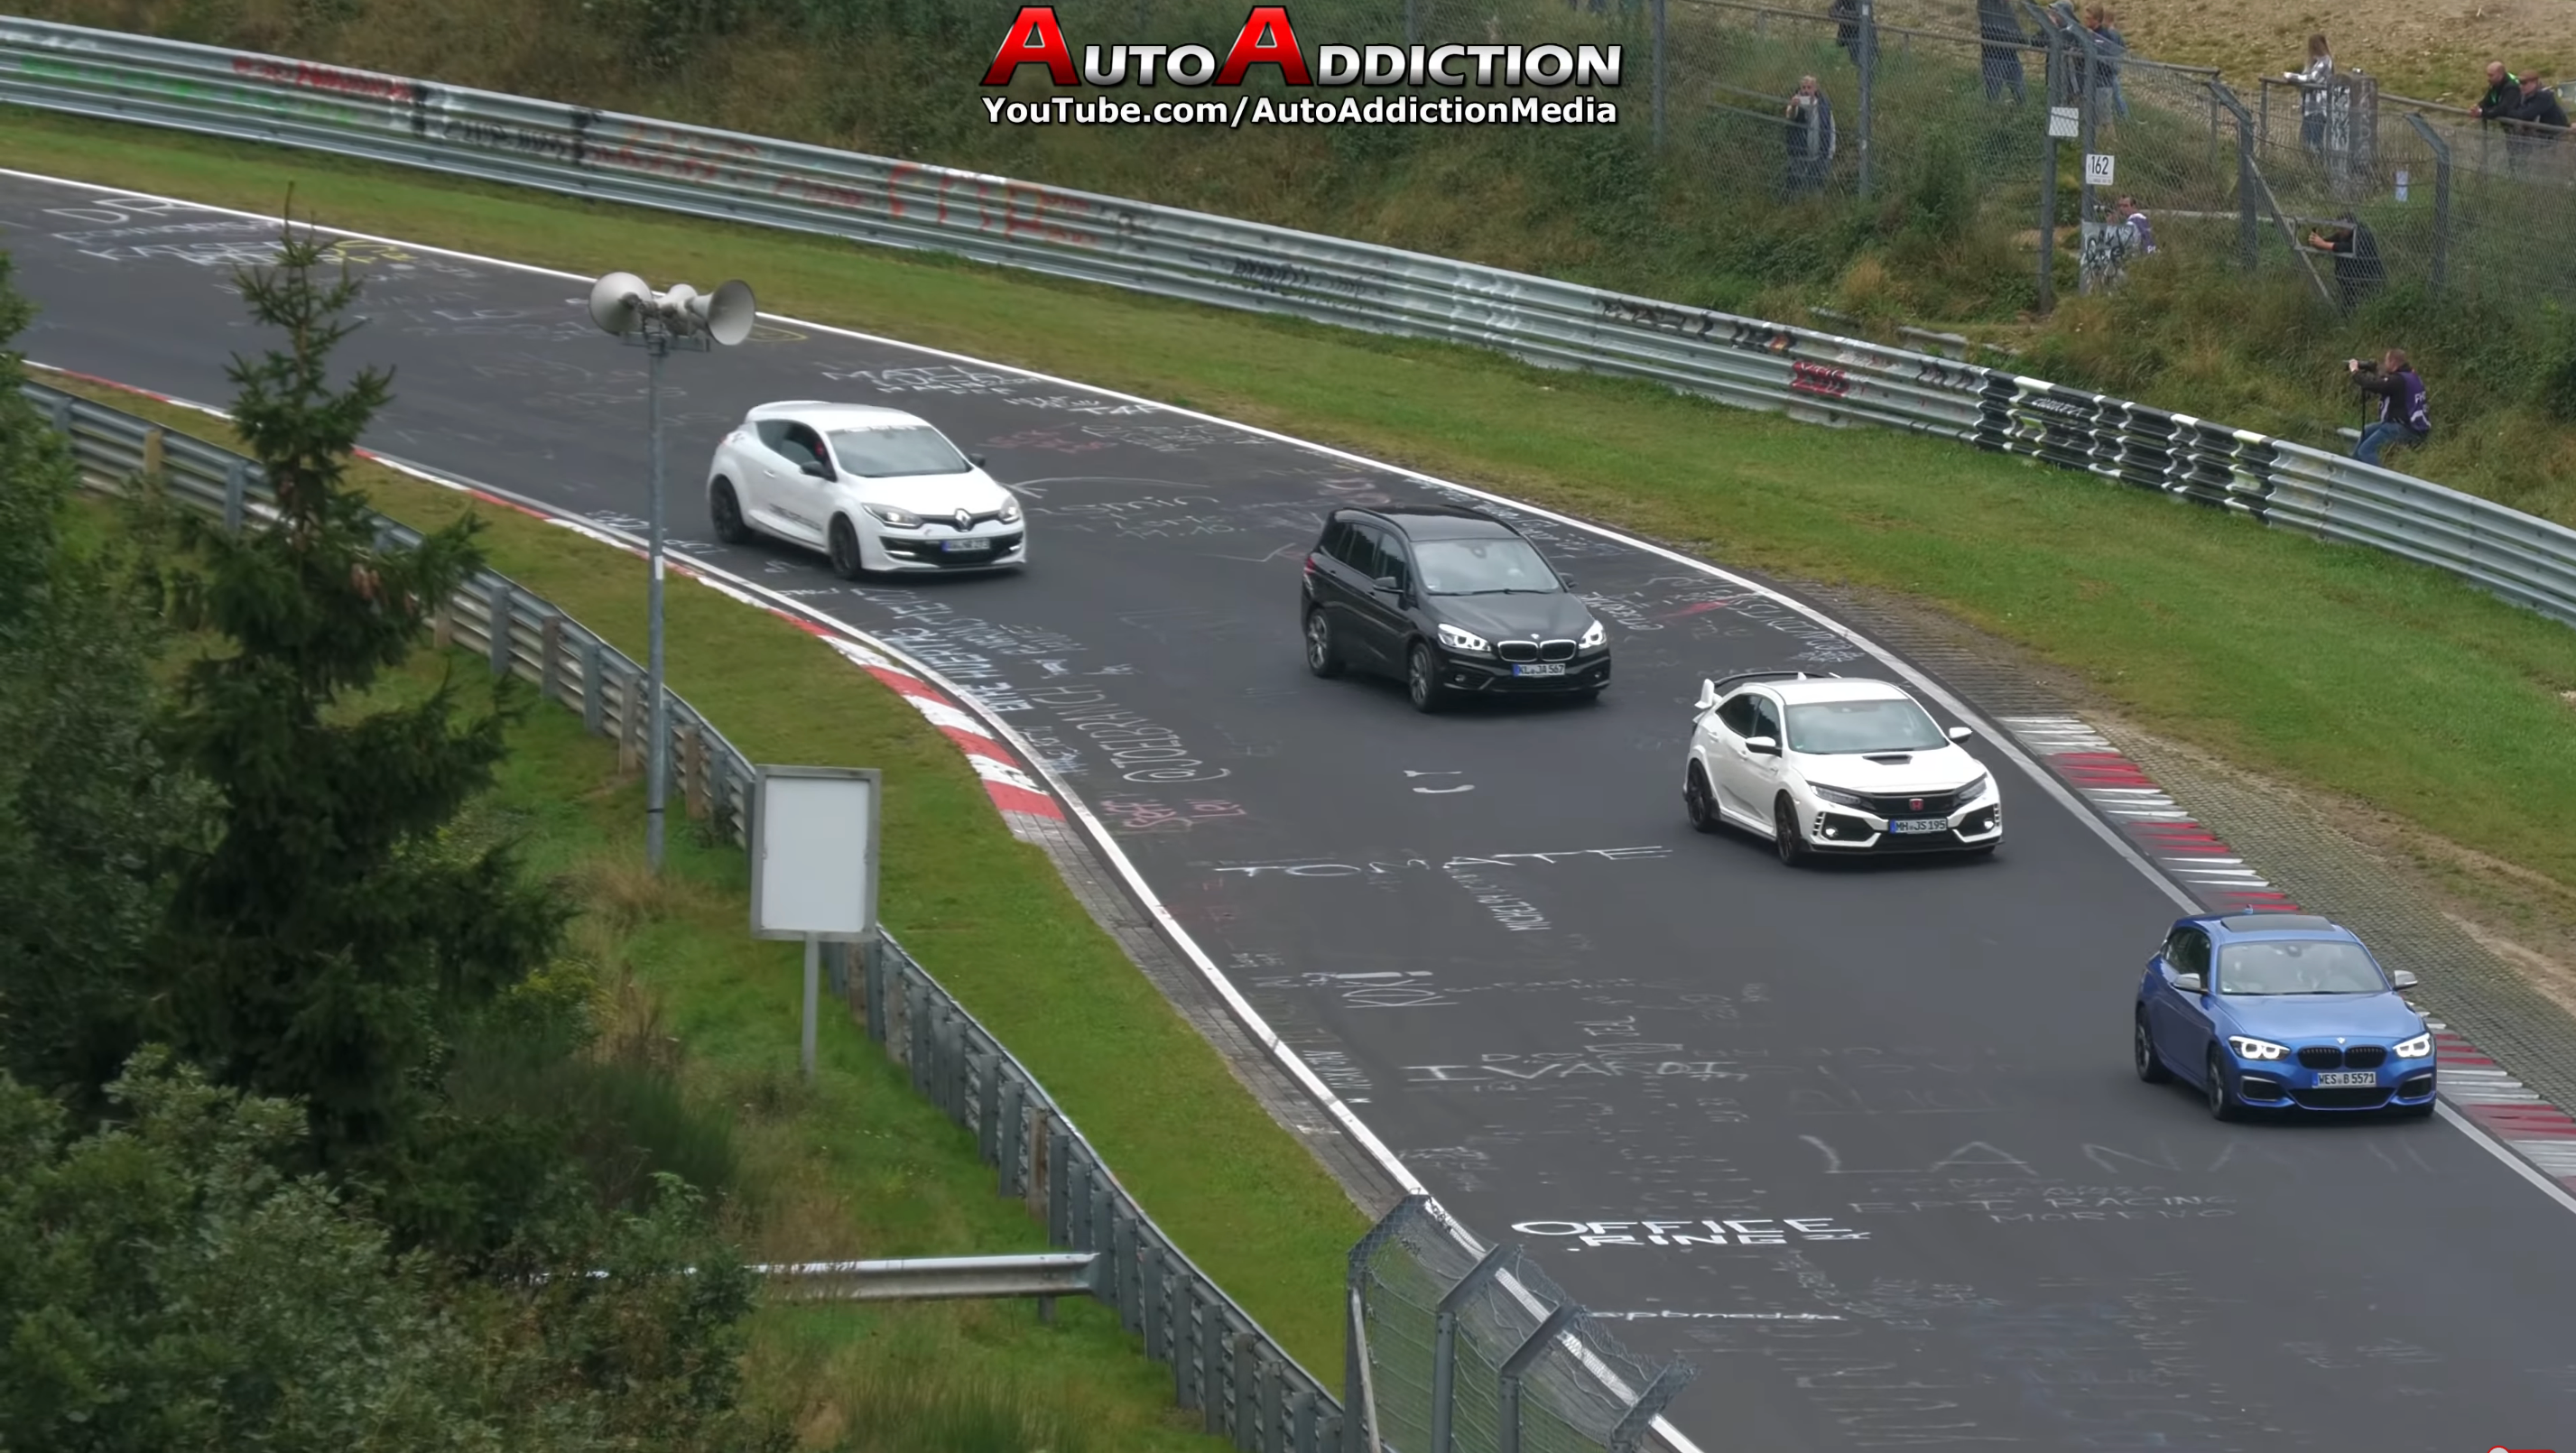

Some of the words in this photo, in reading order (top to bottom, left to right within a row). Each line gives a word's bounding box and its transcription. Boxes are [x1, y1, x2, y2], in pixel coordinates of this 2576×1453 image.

[2090, 155, 2110, 175] 162
[1549, 664, 1564, 673] 567
[1896, 822, 1908, 830] MH
[1914, 821, 1926, 830] JS
[1929, 820, 1945, 829] 195
[2319, 1074, 2337, 1084] WES
[2343, 1074, 2349, 1083] B
[2351, 1073, 2375, 1083] 5571
[1511, 1218, 1853, 1236] OFFICE
[1579, 1234, 1787, 1246] RING
